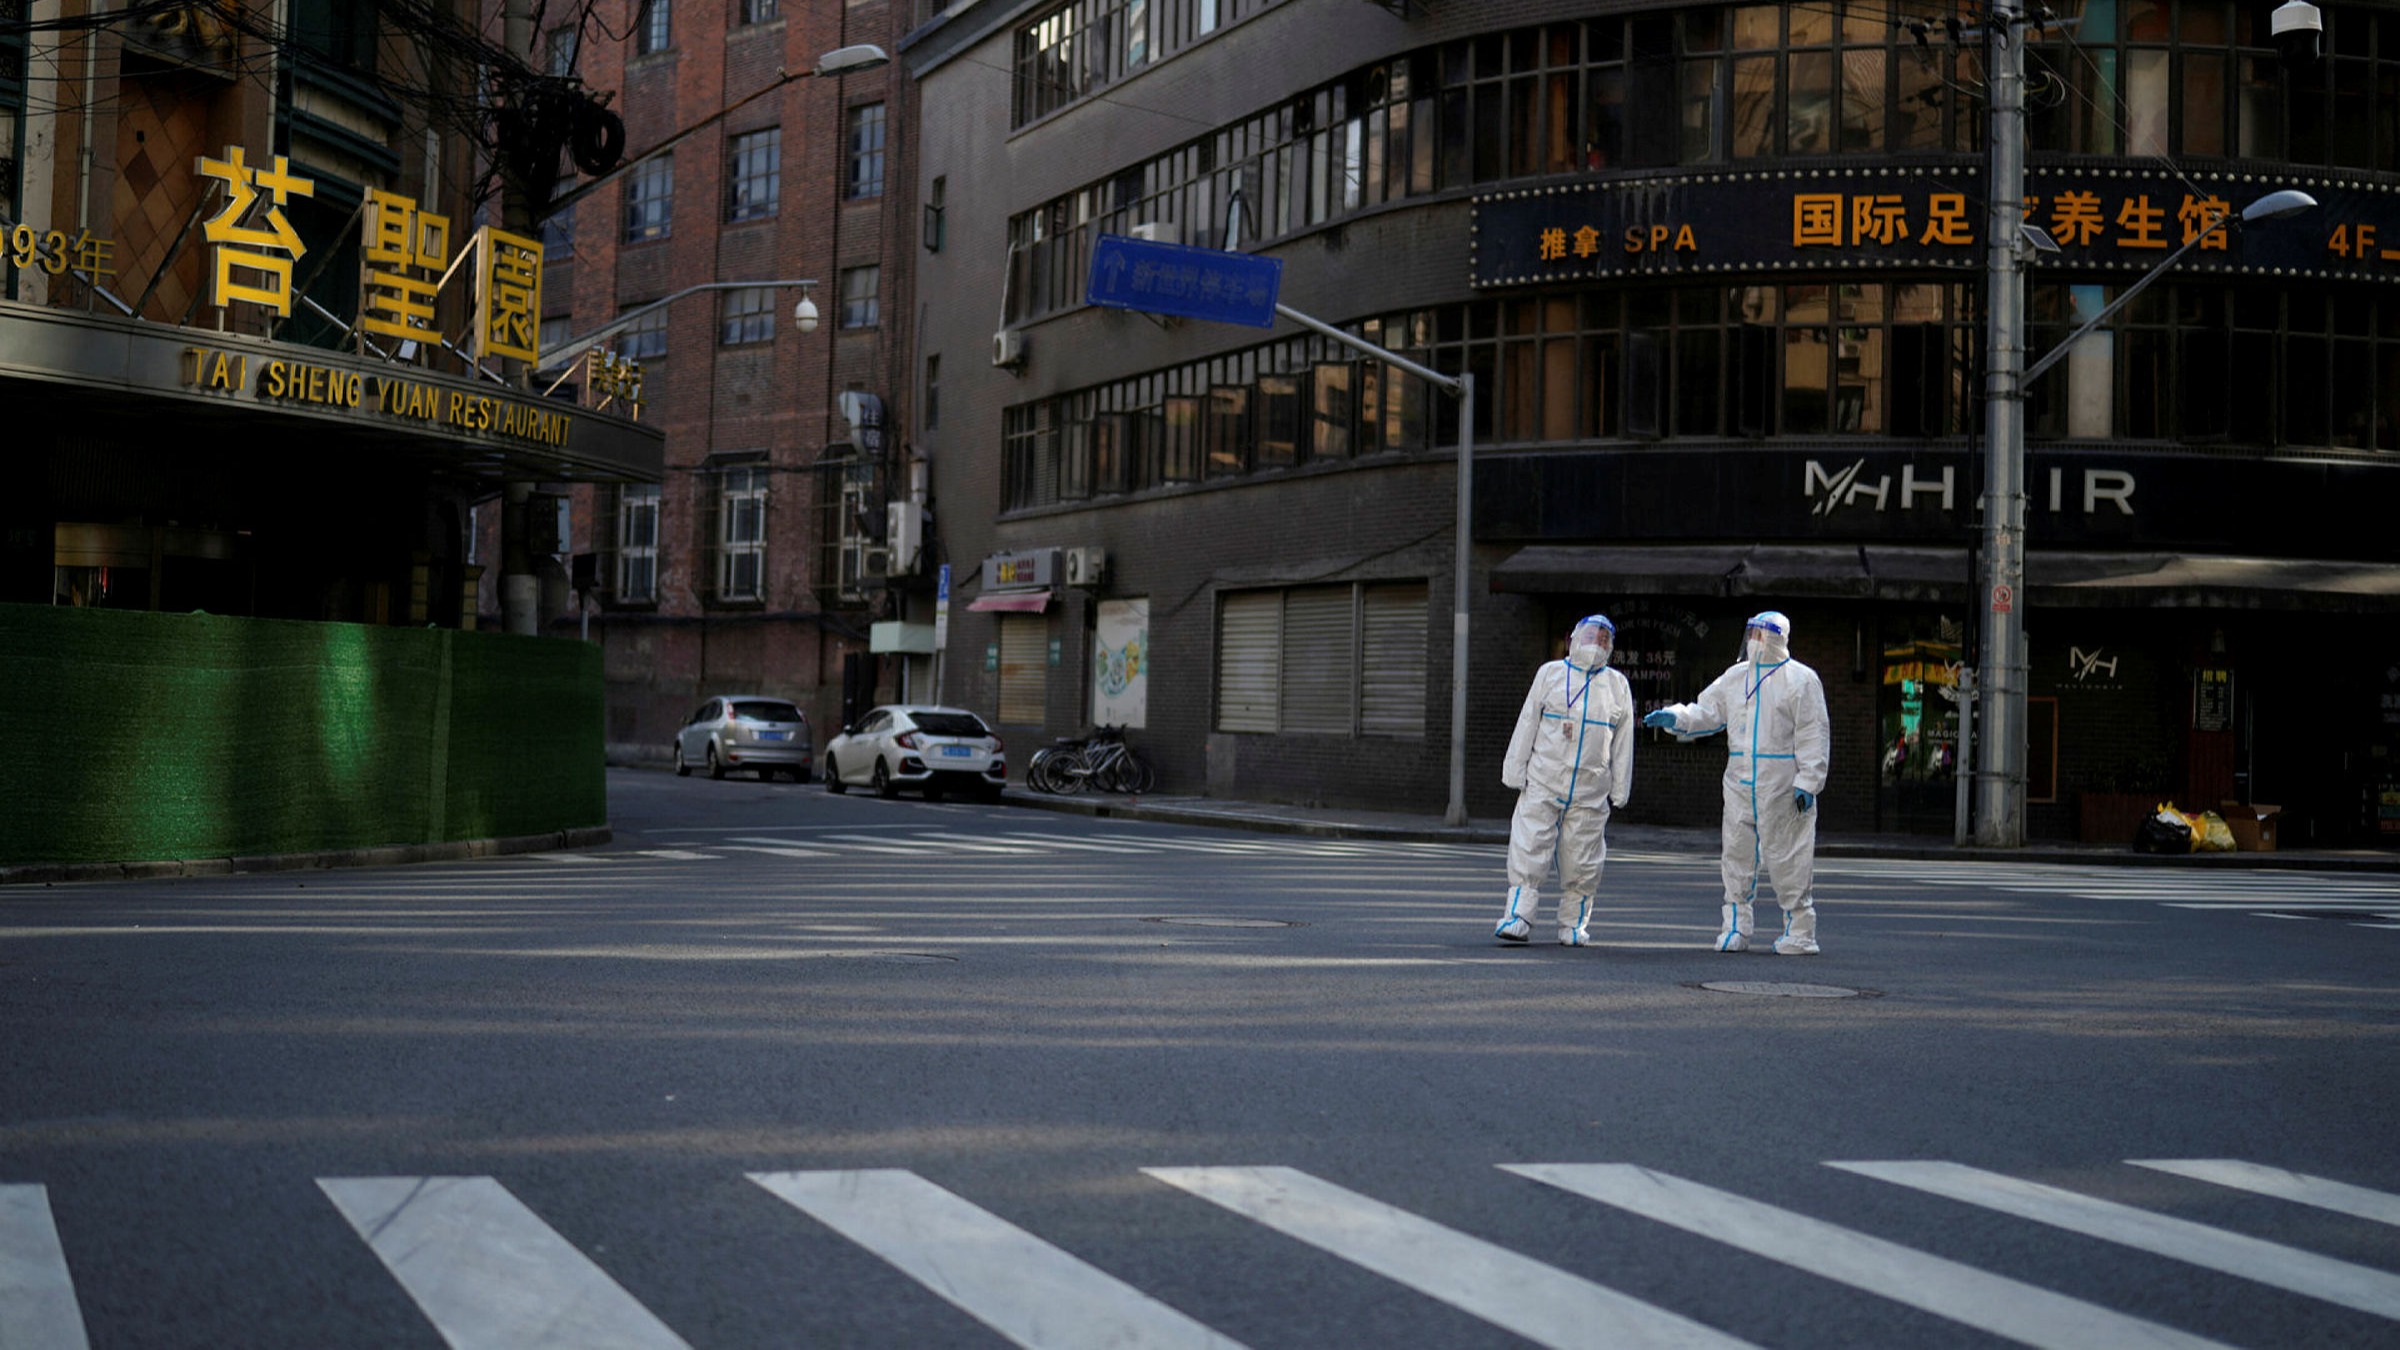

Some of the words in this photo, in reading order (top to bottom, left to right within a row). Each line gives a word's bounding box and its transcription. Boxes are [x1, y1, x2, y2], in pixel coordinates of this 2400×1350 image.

[0, 223, 118, 286] 93年
[1540, 224, 1600, 261] 推拿
[1624, 222, 1698, 254] SPA
[192, 347, 247, 391] TAI
[268, 360, 362, 407] SHENG
[377, 377, 440, 420] YUAN
[450, 391, 572, 447] RESTAURANT
[1900, 463, 2136, 516] HIR
